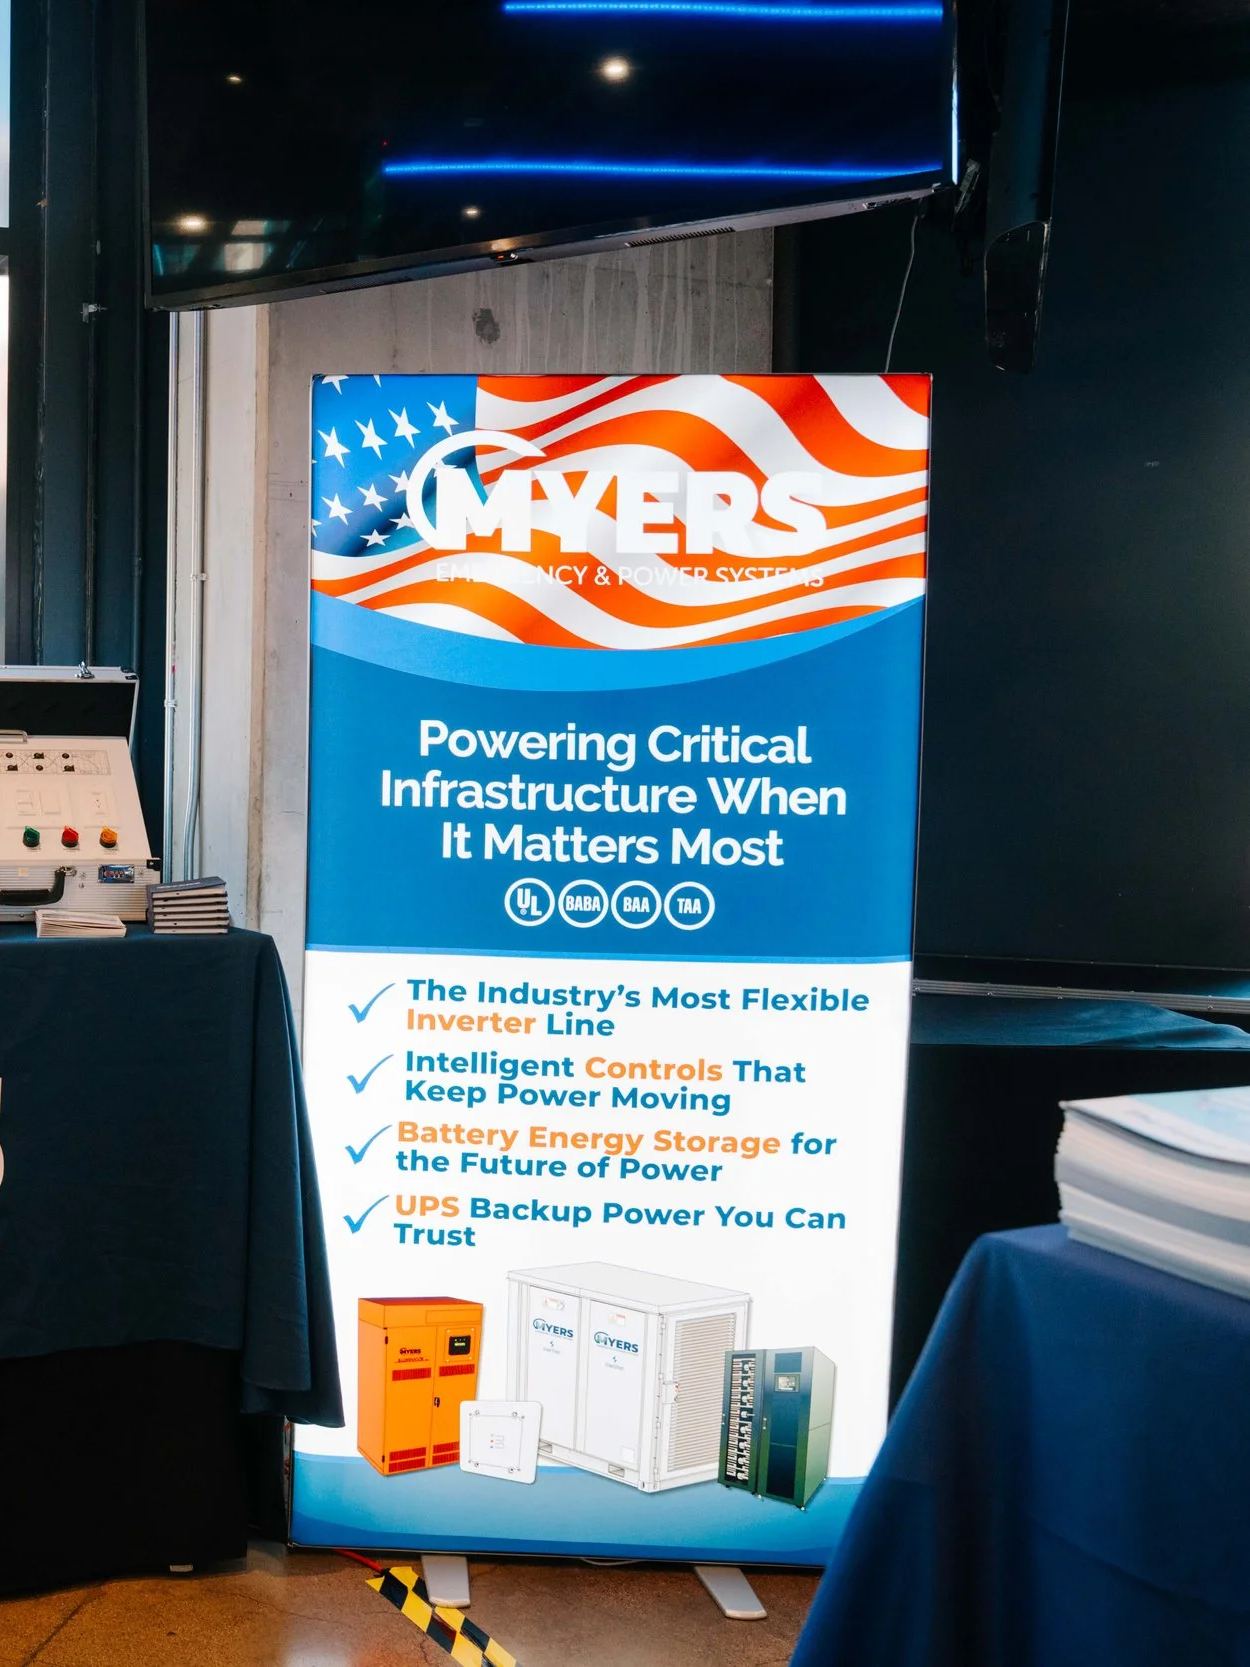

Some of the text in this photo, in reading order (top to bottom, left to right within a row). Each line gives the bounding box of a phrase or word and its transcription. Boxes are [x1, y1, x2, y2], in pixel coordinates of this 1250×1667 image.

[435, 466, 827, 559] MYERS
[436, 563, 825, 588] EMNCY & POWER SYSTES
[419, 719, 812, 772] Powering Critical
[381, 769, 847, 816] Infrastructure When
[441, 821, 785, 867] It Matters Most
[565, 895, 601, 912] BABA
[622, 896, 650, 913] BAA
[676, 898, 702, 914] TAA
[407, 978, 467, 1002] The
[651, 986, 731, 1010] Most
[741, 987, 870, 1012] Flexible
[406, 1008, 616, 1036] Inverter Line
[406, 1050, 806, 1083] Intelligent Controls That
[405, 1079, 731, 1116] Keep Power Moving
[397, 1121, 837, 1159] Battery Energy Storage for
[396, 1150, 723, 1182] the Future of Power
[395, 1194, 846, 1230] UPS Backup Power You Can
[394, 1223, 476, 1248] Trust
[534, 1319, 574, 1338] MYERS
[595, 1333, 639, 1353] MYERS
